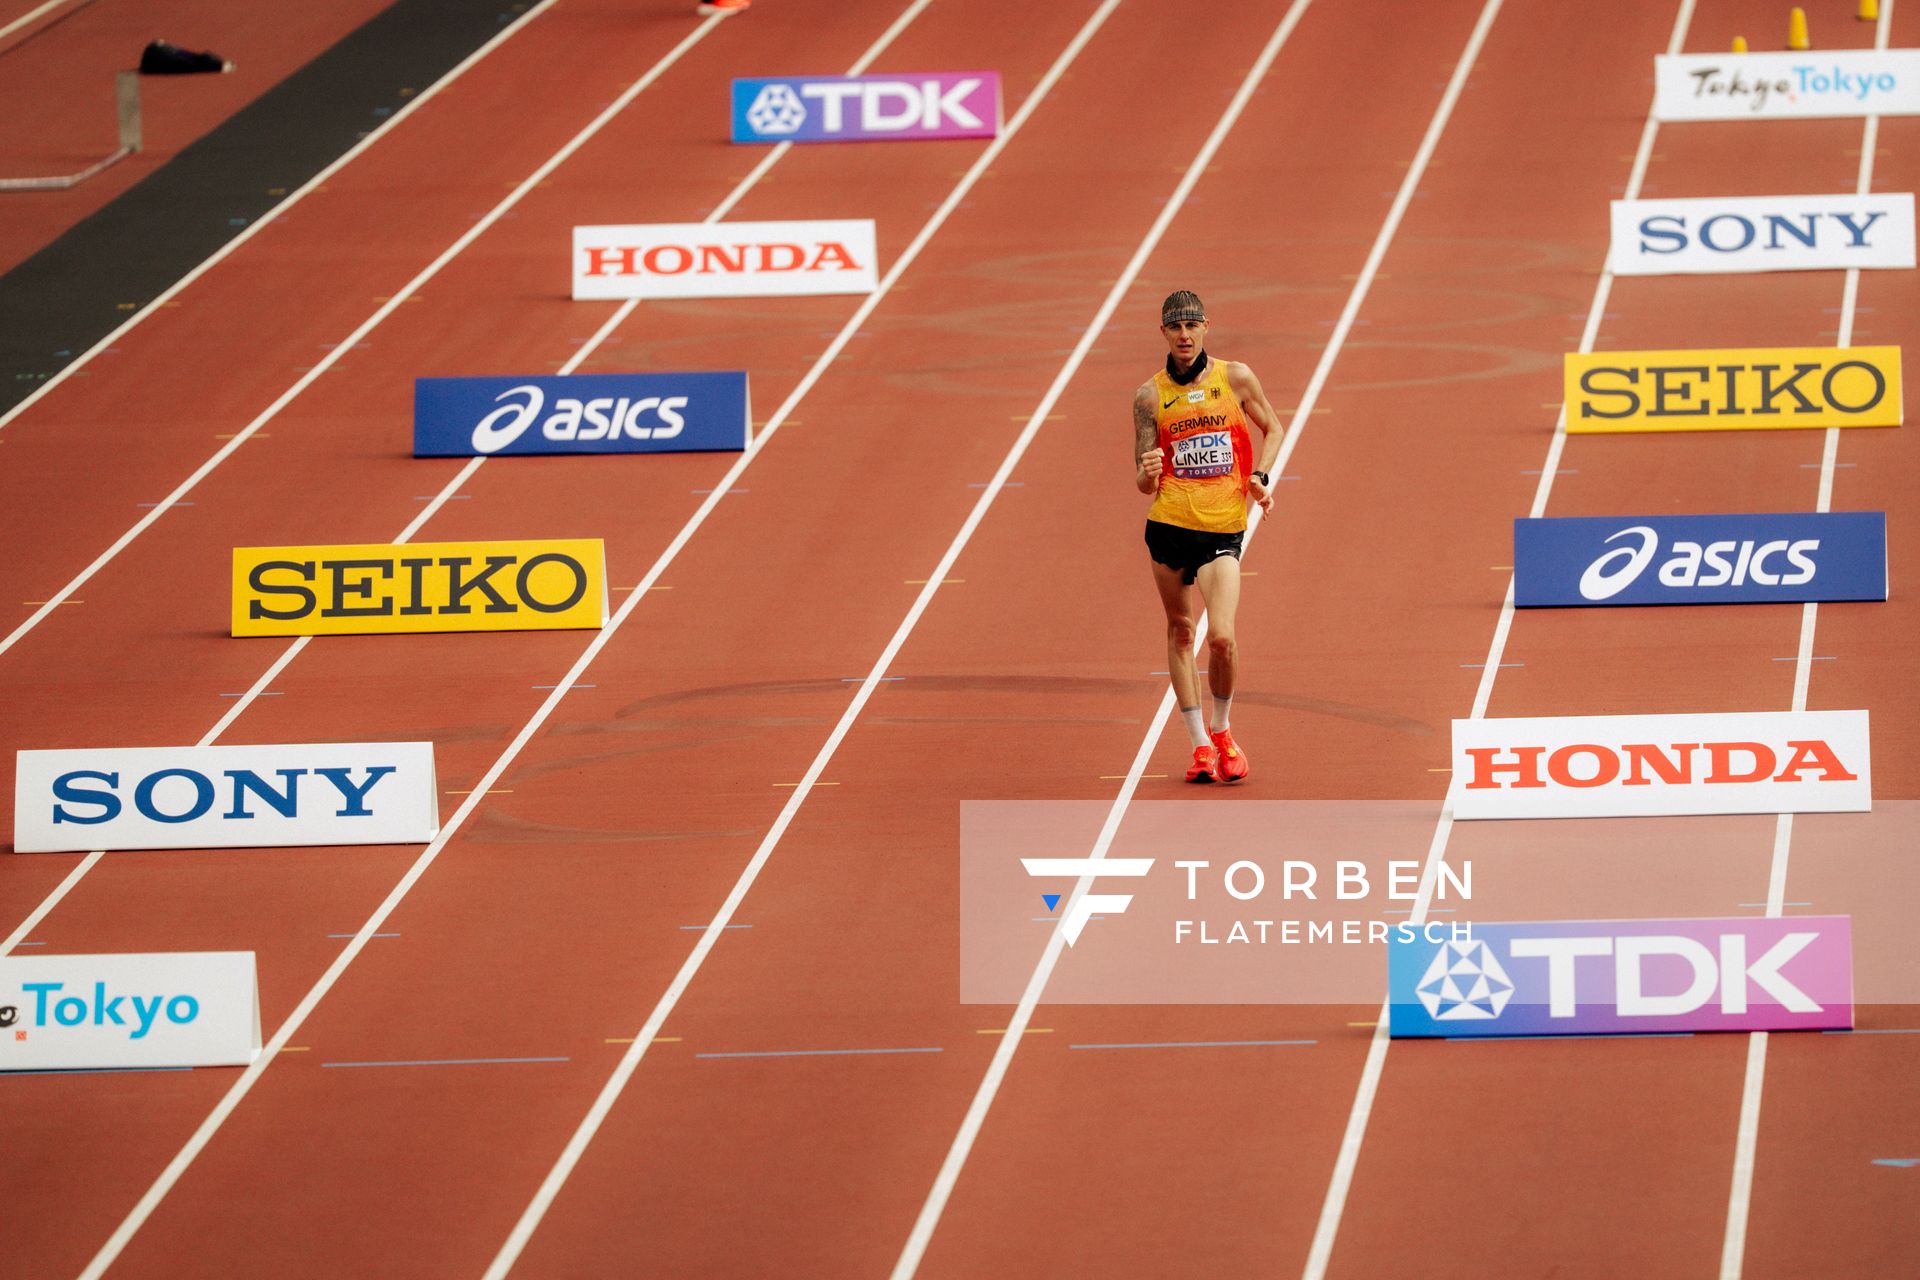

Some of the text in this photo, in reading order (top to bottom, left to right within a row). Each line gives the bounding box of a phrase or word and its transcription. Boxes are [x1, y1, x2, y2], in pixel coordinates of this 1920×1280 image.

[801, 77, 983, 132] TDK
[1689, 66, 1896, 111] Tokyo Tokyo
[1639, 211, 1888, 254] SONY
[582, 242, 862, 277] HONDA
[1580, 360, 1886, 419] SEIKO
[543, 396, 689, 440] asics
[1169, 415, 1227, 434] GERMANY
[1188, 434, 1227, 449] TDK
[1175, 450, 1218, 466] LINKE
[249, 552, 588, 619] SEIKO
[1658, 539, 1818, 588] asics
[1465, 740, 1858, 790] HONDA
[52, 766, 396, 824] SONY
[1509, 932, 1824, 1020] TDK
[22, 982, 199, 1040] Tokyo
